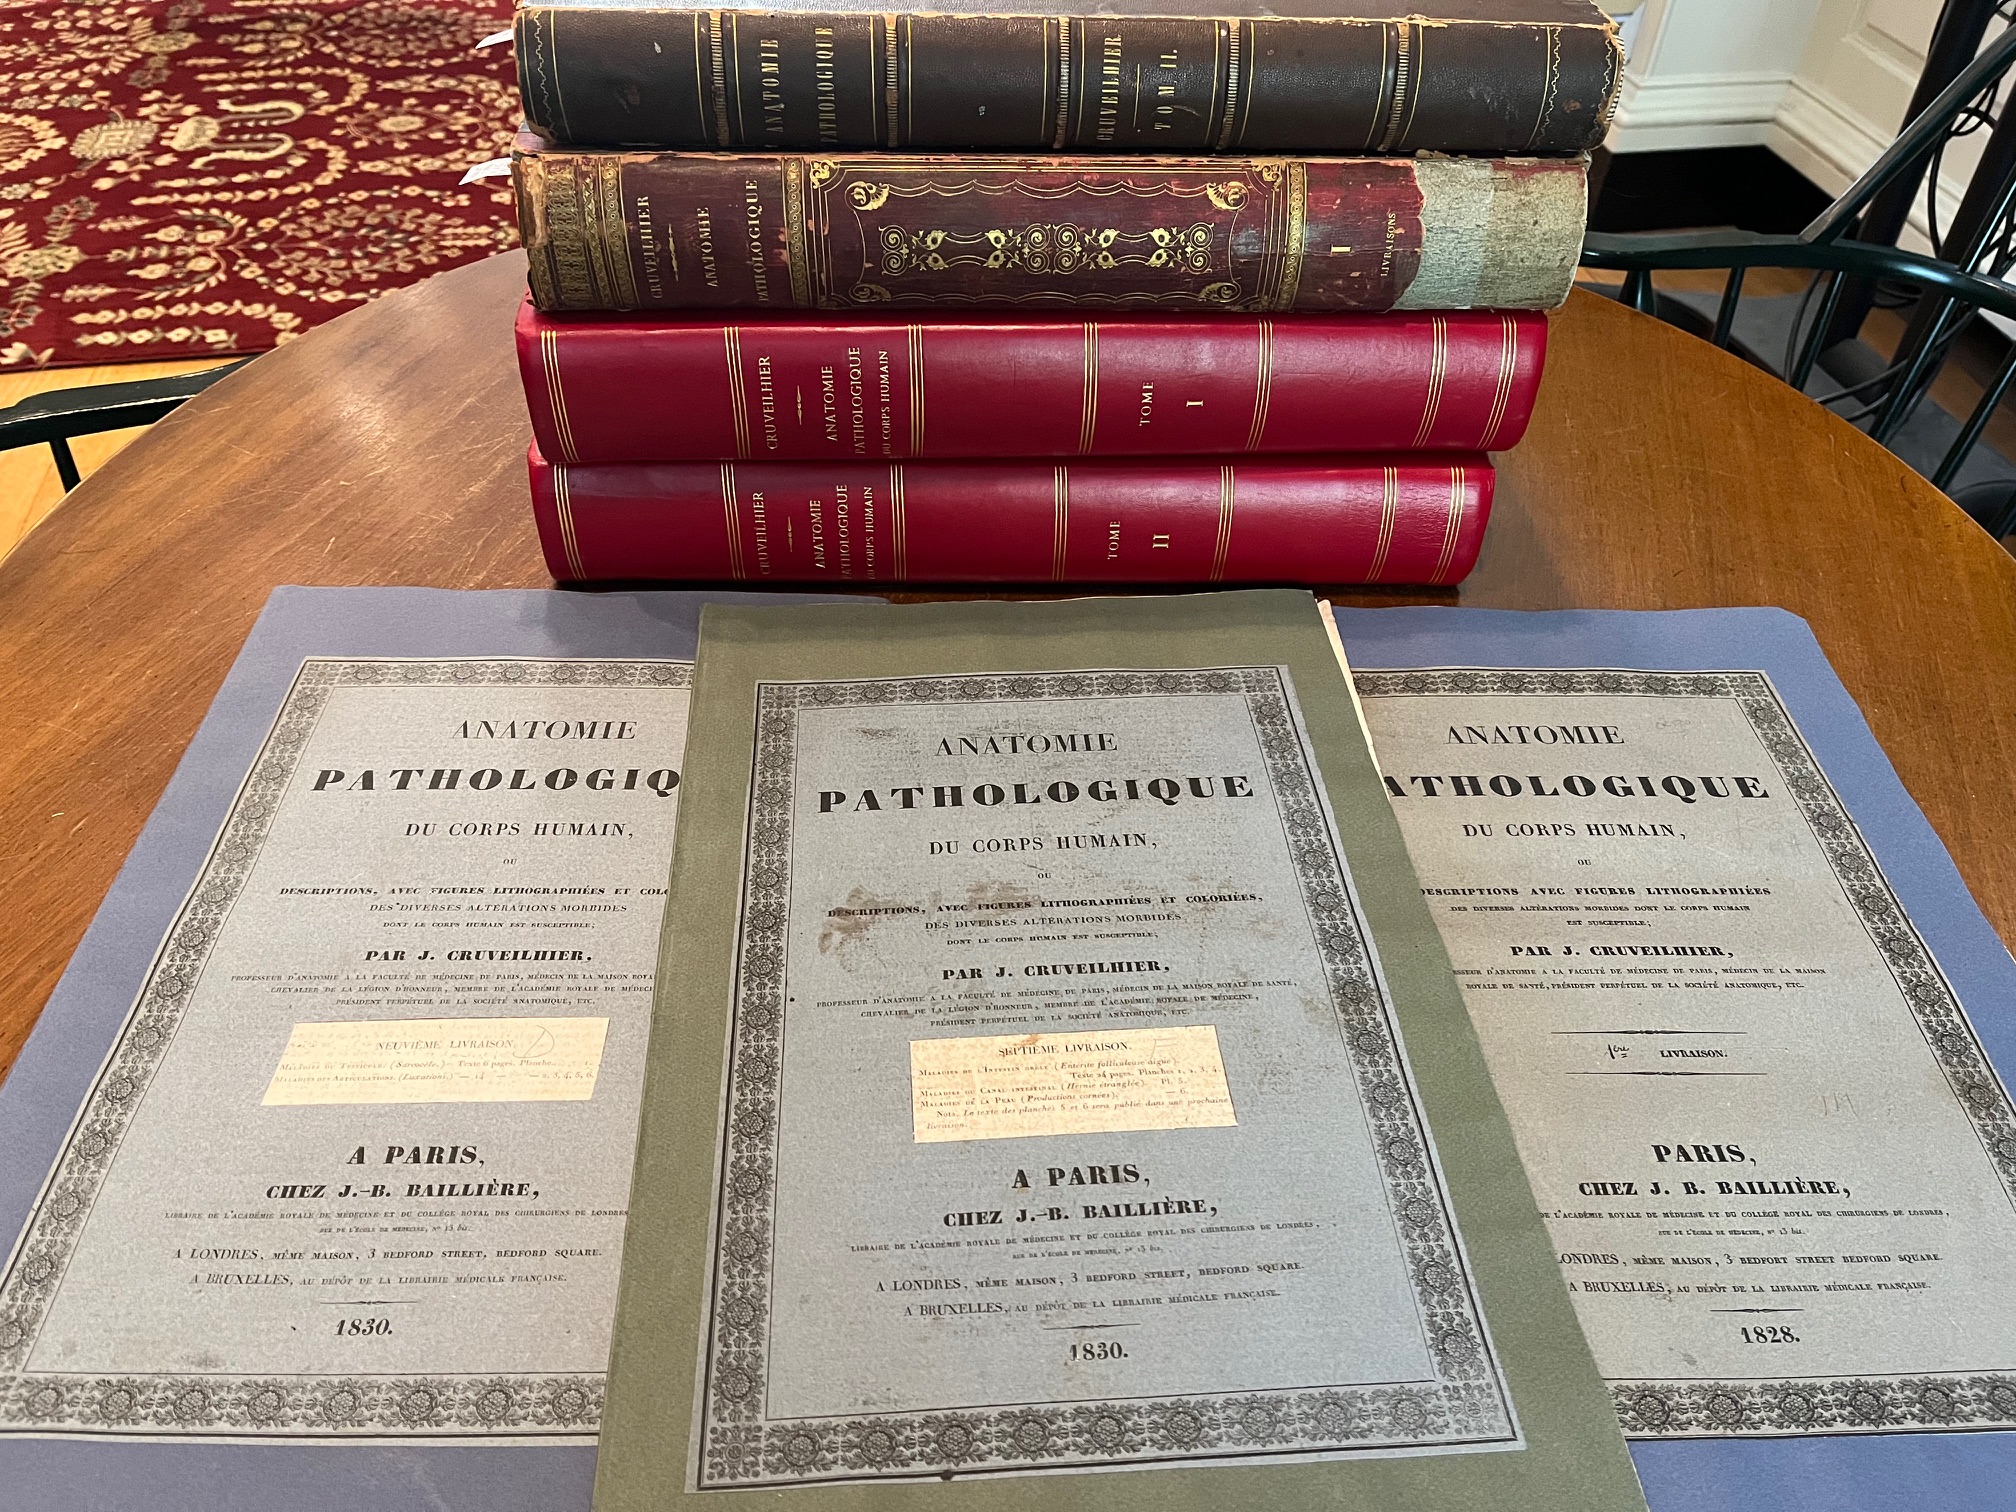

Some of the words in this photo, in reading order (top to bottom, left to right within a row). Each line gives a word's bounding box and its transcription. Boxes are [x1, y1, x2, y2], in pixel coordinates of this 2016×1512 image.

[815, 27, 838, 144] PATHOLOGIQUE
[697, 207, 719, 287] ANATOMIE
[746, 180, 770, 302] PATHOLOGIQUE
[1380, 213, 1397, 277] LIVRAISONS
[878, 350, 890, 402] HUMAIN
[759, 356, 778, 450] CRUVEILHIER
[821, 366, 838, 441] ANATOMIE
[848, 347, 866, 455] PATHOLOGIQUE
[1139, 382, 1154, 426] TOME
[881, 405, 891, 435] CORPS
[862, 486, 875, 531] HUMAIN
[753, 491, 771, 575] CRUVEILHIER
[810, 500, 827, 569] ANATOMIE
[837, 484, 853, 580] PATHOLOGIQUE
[1107, 521, 1120, 560] TOME
[1153, 534, 1170, 548] II
[864, 532, 876, 558] CORPS
[454, 721, 637, 739] ANATOMIE
[1444, 726, 1624, 744] ANATOMIE
[936, 733, 1117, 756] ANATOMIE
[312, 768, 679, 797] PATHOLOGIQ
[1384, 775, 1769, 803] ATHOLOGIQUE
[818, 776, 1253, 813] PATHOLOGIQUE
[406, 824, 436, 836] DU
[449, 823, 520, 835] CORPS
[534, 823, 634, 839] HUMAIN,
[1463, 824, 1494, 836] DU
[1506, 824, 1576, 836] CORPS
[1586, 824, 1685, 839] HUMAIN,
[930, 841, 958, 854] DU
[973, 837, 1043, 853] CORPS
[1057, 833, 1157, 850] HUMAIN,
[493, 885, 605, 894] LITHOGRAPHIÉES
[1646, 885, 1771, 895] LITHOGRAPHIÉES
[828, 906, 926, 917] DESCRIPTIONS,
[937, 904, 968, 912] AVEC
[978, 901, 1032, 910] FIGURES
[1040, 895, 1151, 907] LITHOGRAPHIÉES
[1186, 892, 1262, 904] COLORIÉES,
[925, 921, 948, 931] DES
[956, 920, 1016, 928] DIVERSES
[1116, 911, 1181, 922] MORBIDES
[365, 951, 405, 961] PAR
[418, 951, 435, 960] J.
[1511, 946, 1552, 956] PAR
[1563, 946, 1580, 955] J.
[1590, 946, 1734, 958] CRUVEILHIER,
[943, 968, 982, 980] PAR
[996, 967, 1012, 977] J.
[1024, 961, 1169, 976] CRUVEILHIER,
[377, 1039, 441, 1050] NEUVIÈME
[450, 1039, 516, 1048] LIVRAISON.
[1065, 1042, 1131, 1052] LIVRAISON.
[347, 1146, 364, 1164] A
[384, 1146, 486, 1168] PARIS,
[1651, 1145, 1757, 1166] PARIS,
[1012, 1169, 1030, 1188] A
[1047, 1164, 1151, 1187] PARIS,
[267, 1185, 326, 1198] CHEZ
[338, 1185, 391, 1197] J.-B.
[406, 1179, 539, 1200] BAILLIÈRE,
[1579, 1182, 1638, 1196] CHEZ
[1650, 1182, 1669, 1195] J.
[1683, 1182, 1705, 1194] B.
[1716, 1177, 1850, 1198] BAILLIÈRE,
[944, 1211, 1003, 1226] CHEZ
[1016, 1207, 1069, 1222] J.-B.
[1083, 1196, 1217, 1218] BAILLIÈRE,
[175, 1249, 180, 1258] A
[190, 1249, 263, 1260] LONDRES,
[273, 1249, 305, 1259] MÊME
[311, 1252, 359, 1260] MAISON,
[368, 1248, 376, 1258] 3
[497, 1250, 547, 1258] BEDFORD
[555, 1249, 601, 1259] SQUARE.
[1671, 1257, 1719, 1267] MAISON,
[1724, 1254, 1733, 1264] 3
[1842, 1255, 1891, 1263] BEDFORD
[1898, 1254, 1942, 1264] SQUARE.
[190, 1274, 198, 1284] A
[206, 1274, 293, 1286] BRUXELLES,
[322, 1275, 353, 1285] DÉPÔT
[455, 1274, 504, 1283] MÉDICALE
[511, 1274, 566, 1285] FRANÇAISE.
[878, 1282, 885, 1291] A
[893, 1278, 967, 1291] LONDRES,
[1016, 1277, 1063, 1286] MAISON,
[1071, 1273, 1078, 1282] 3
[1086, 1273, 1136, 1282] BEDFORD
[1144, 1270, 1190, 1279] STREET,
[1198, 1266, 1250, 1275] BEDFORD
[1257, 1263, 1304, 1273] SQUARE.
[1570, 1282, 1578, 1291] A
[1583, 1281, 1672, 1294] BRUXELLES,
[1824, 1281, 1873, 1291] MÉDICALE
[1877, 1282, 1931, 1293] FRANÇAISE.
[904, 1307, 912, 1316] A
[920, 1303, 1011, 1315] BRUXELLES,
[1112, 1298, 1162, 1307] LIBRAIRIE
[1168, 1293, 1219, 1303] MÉDICALE
[1224, 1290, 1281, 1301] FRANÇAISE.
[336, 1318, 392, 1335] 1830.
[1741, 1326, 1800, 1343] 1828.
[1070, 1342, 1129, 1360] 1830.
